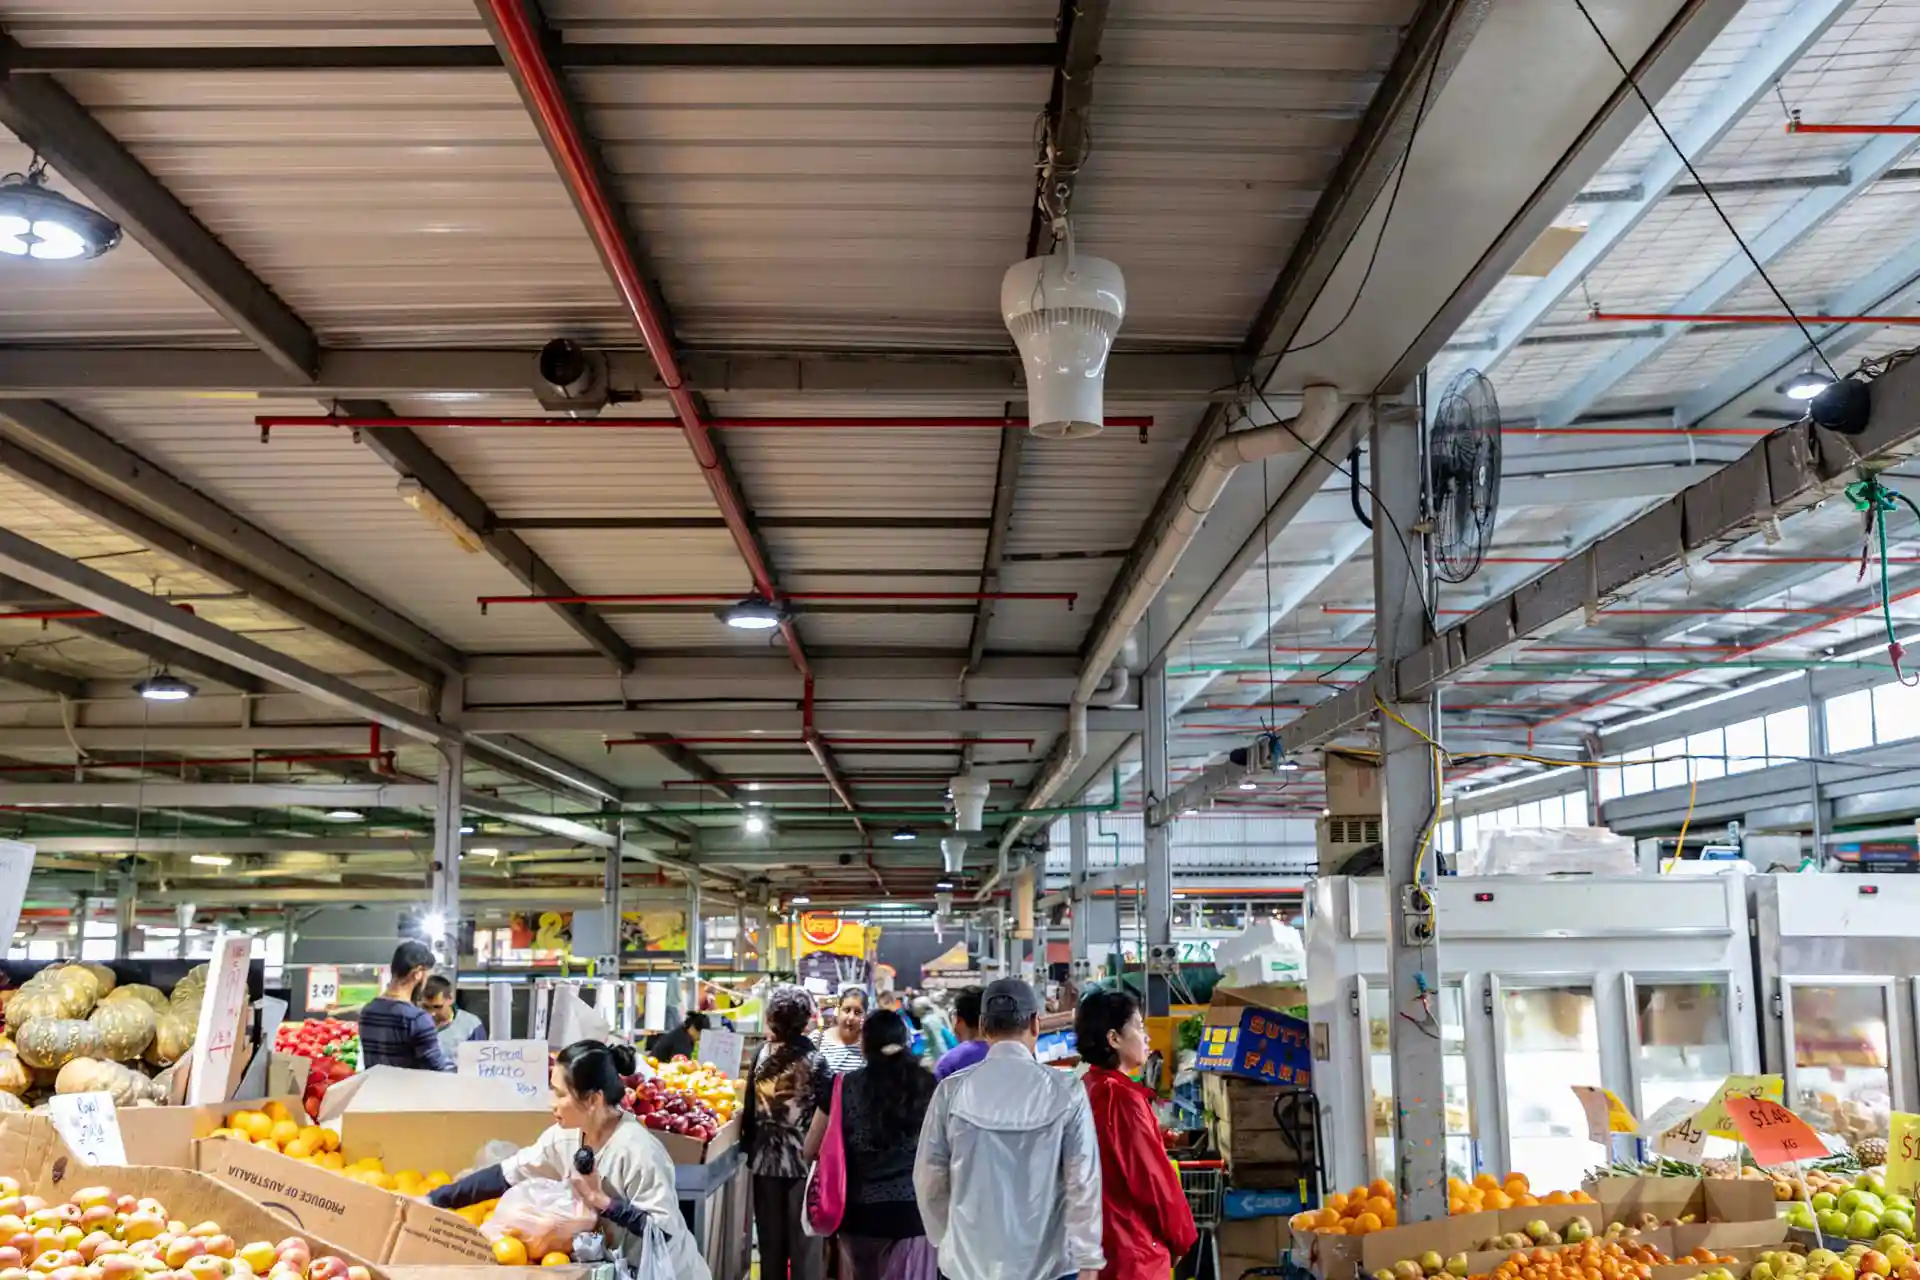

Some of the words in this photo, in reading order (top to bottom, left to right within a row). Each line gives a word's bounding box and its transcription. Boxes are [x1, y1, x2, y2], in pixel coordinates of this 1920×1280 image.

[1249, 1015, 1309, 1051] SUTT
[1780, 1138, 1798, 1151] KG
[228, 1165, 286, 1193] AUSTRALIA
[284, 1186, 298, 1198] OF
[300, 1190, 345, 1215] PRODUCE
